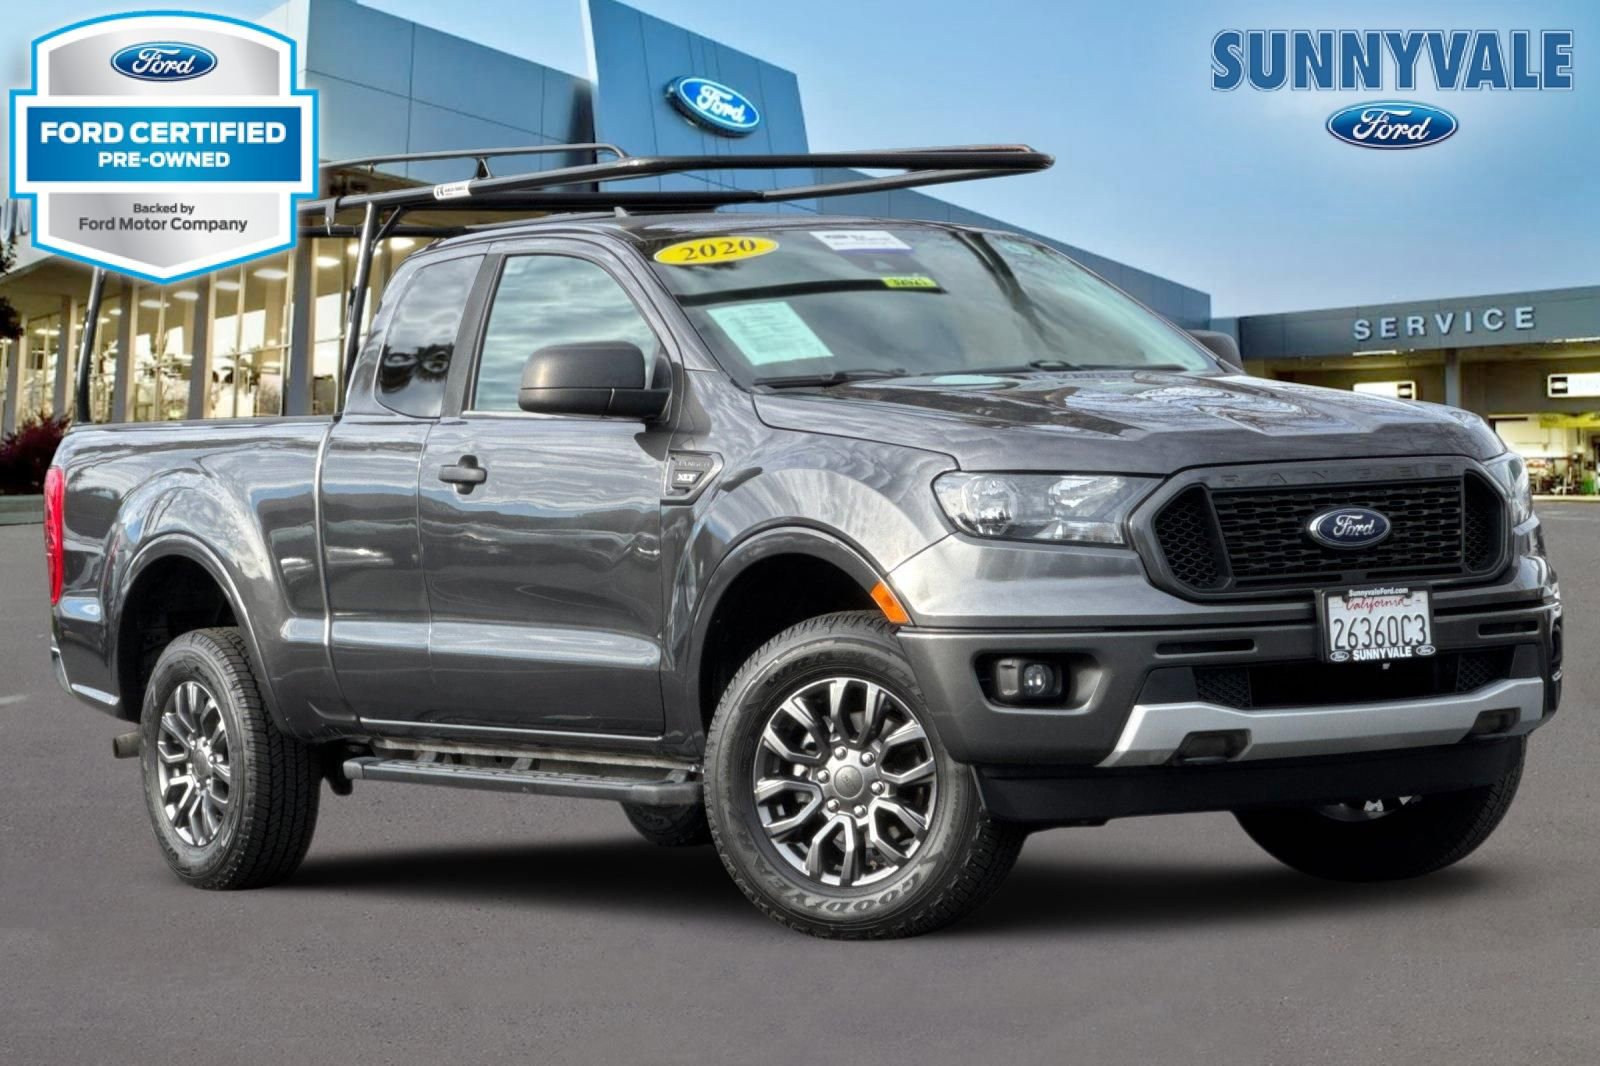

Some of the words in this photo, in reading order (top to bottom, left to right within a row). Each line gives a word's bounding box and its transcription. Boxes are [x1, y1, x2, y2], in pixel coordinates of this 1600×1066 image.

[696, 84, 746, 122] Ford
[681, 239, 757, 260] 2020
[1353, 306, 1535, 340] SERVICE
[677, 473, 696, 482] XLT
[1333, 514, 1375, 537] Ford
[1348, 587, 1409, 598] SunnyvaleFord.com
[1345, 596, 1412, 614] California
[1333, 614, 1427, 650] 26360C3
[1352, 646, 1413, 661] SUNNYVALE
